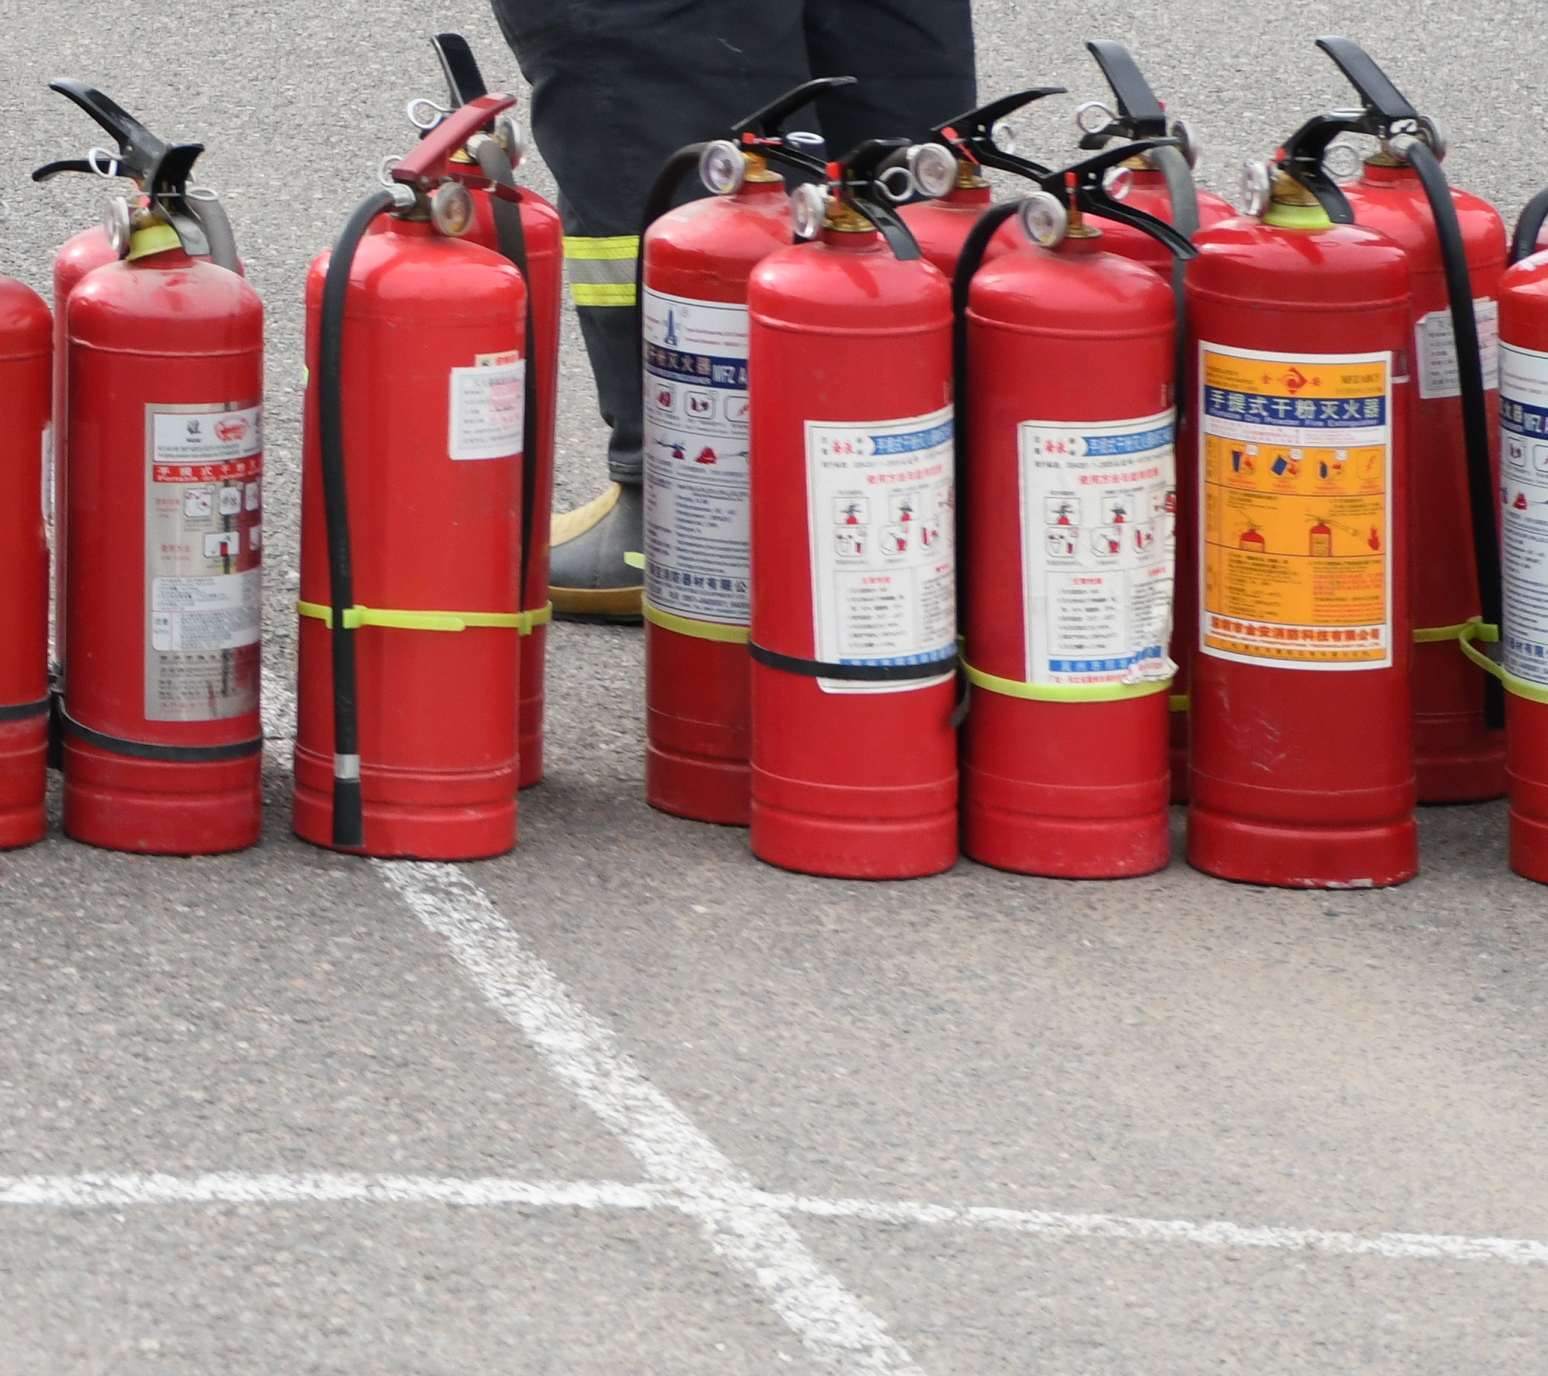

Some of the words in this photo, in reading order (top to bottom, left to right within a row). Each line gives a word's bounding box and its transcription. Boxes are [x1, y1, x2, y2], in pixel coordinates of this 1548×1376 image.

[1211, 389, 1380, 420] 手提式干粉灭火器
